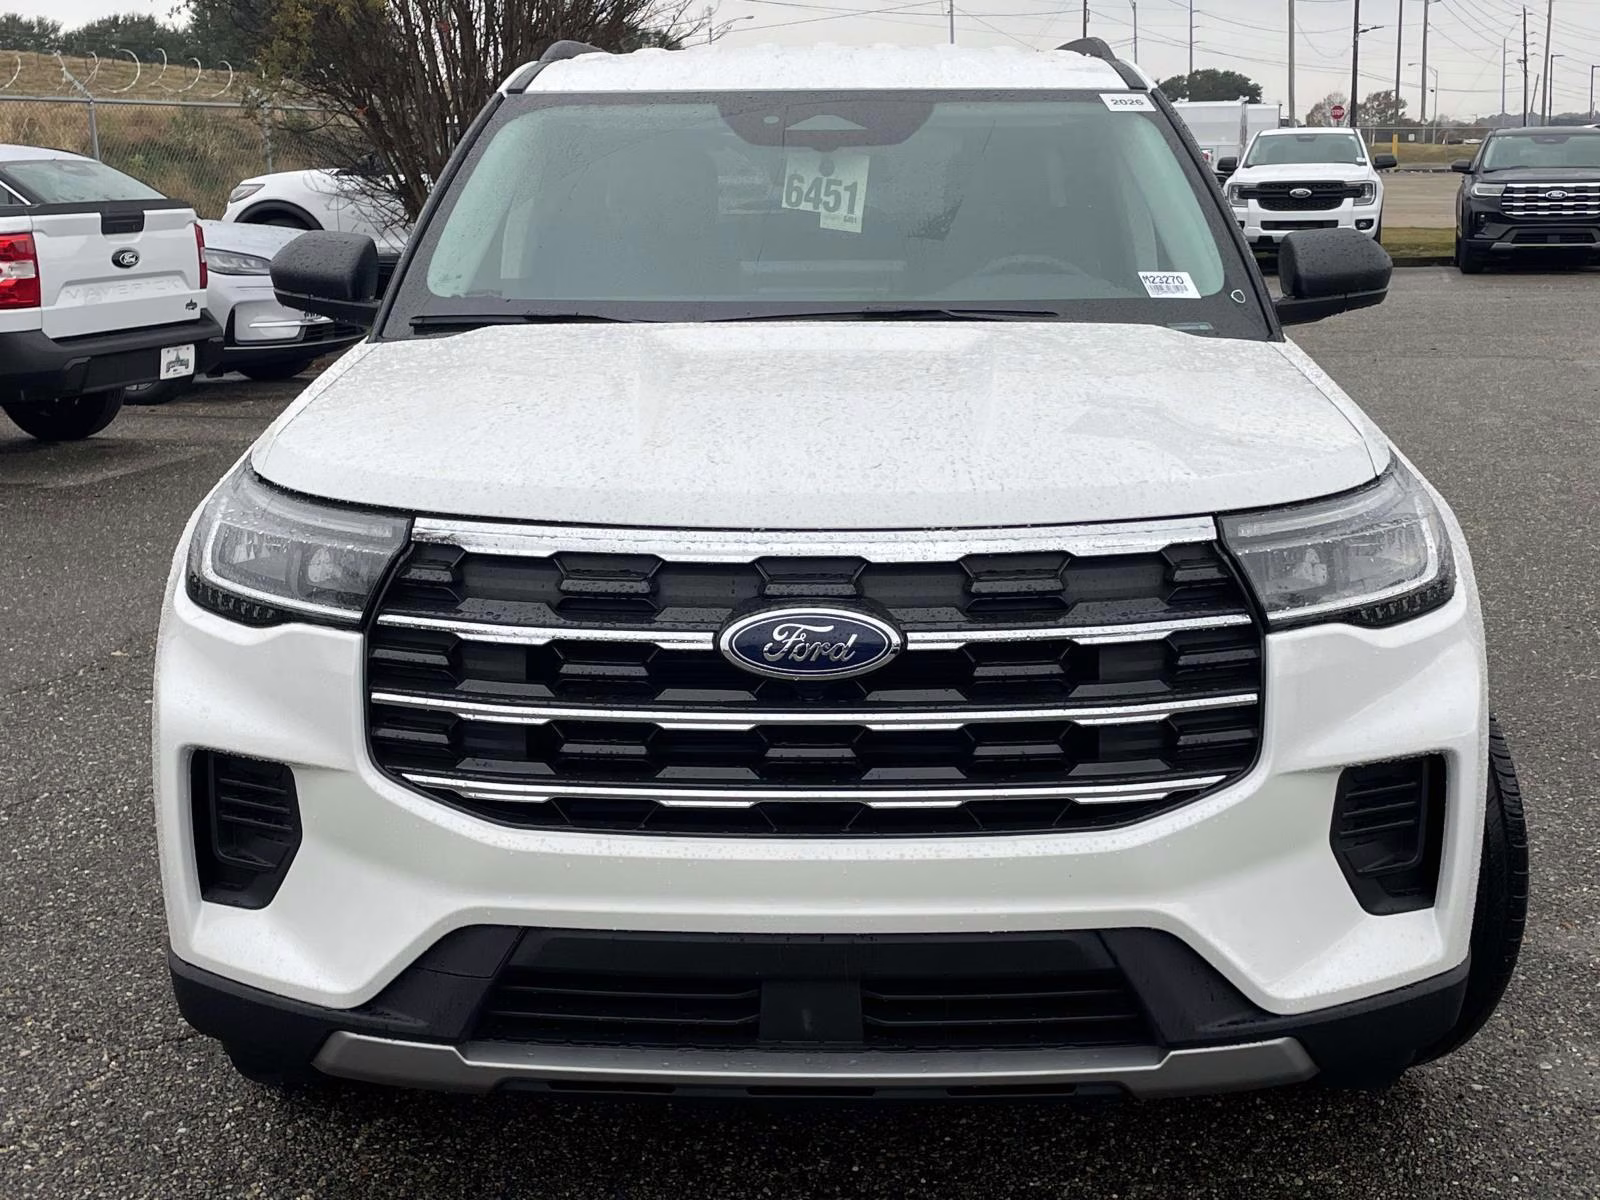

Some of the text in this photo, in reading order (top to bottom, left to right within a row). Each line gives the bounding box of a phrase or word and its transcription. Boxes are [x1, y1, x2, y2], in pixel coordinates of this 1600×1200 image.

[785, 173, 858, 215] 6451
[1142, 275, 1184, 284] M23270
[763, 623, 858, 662] Ford
